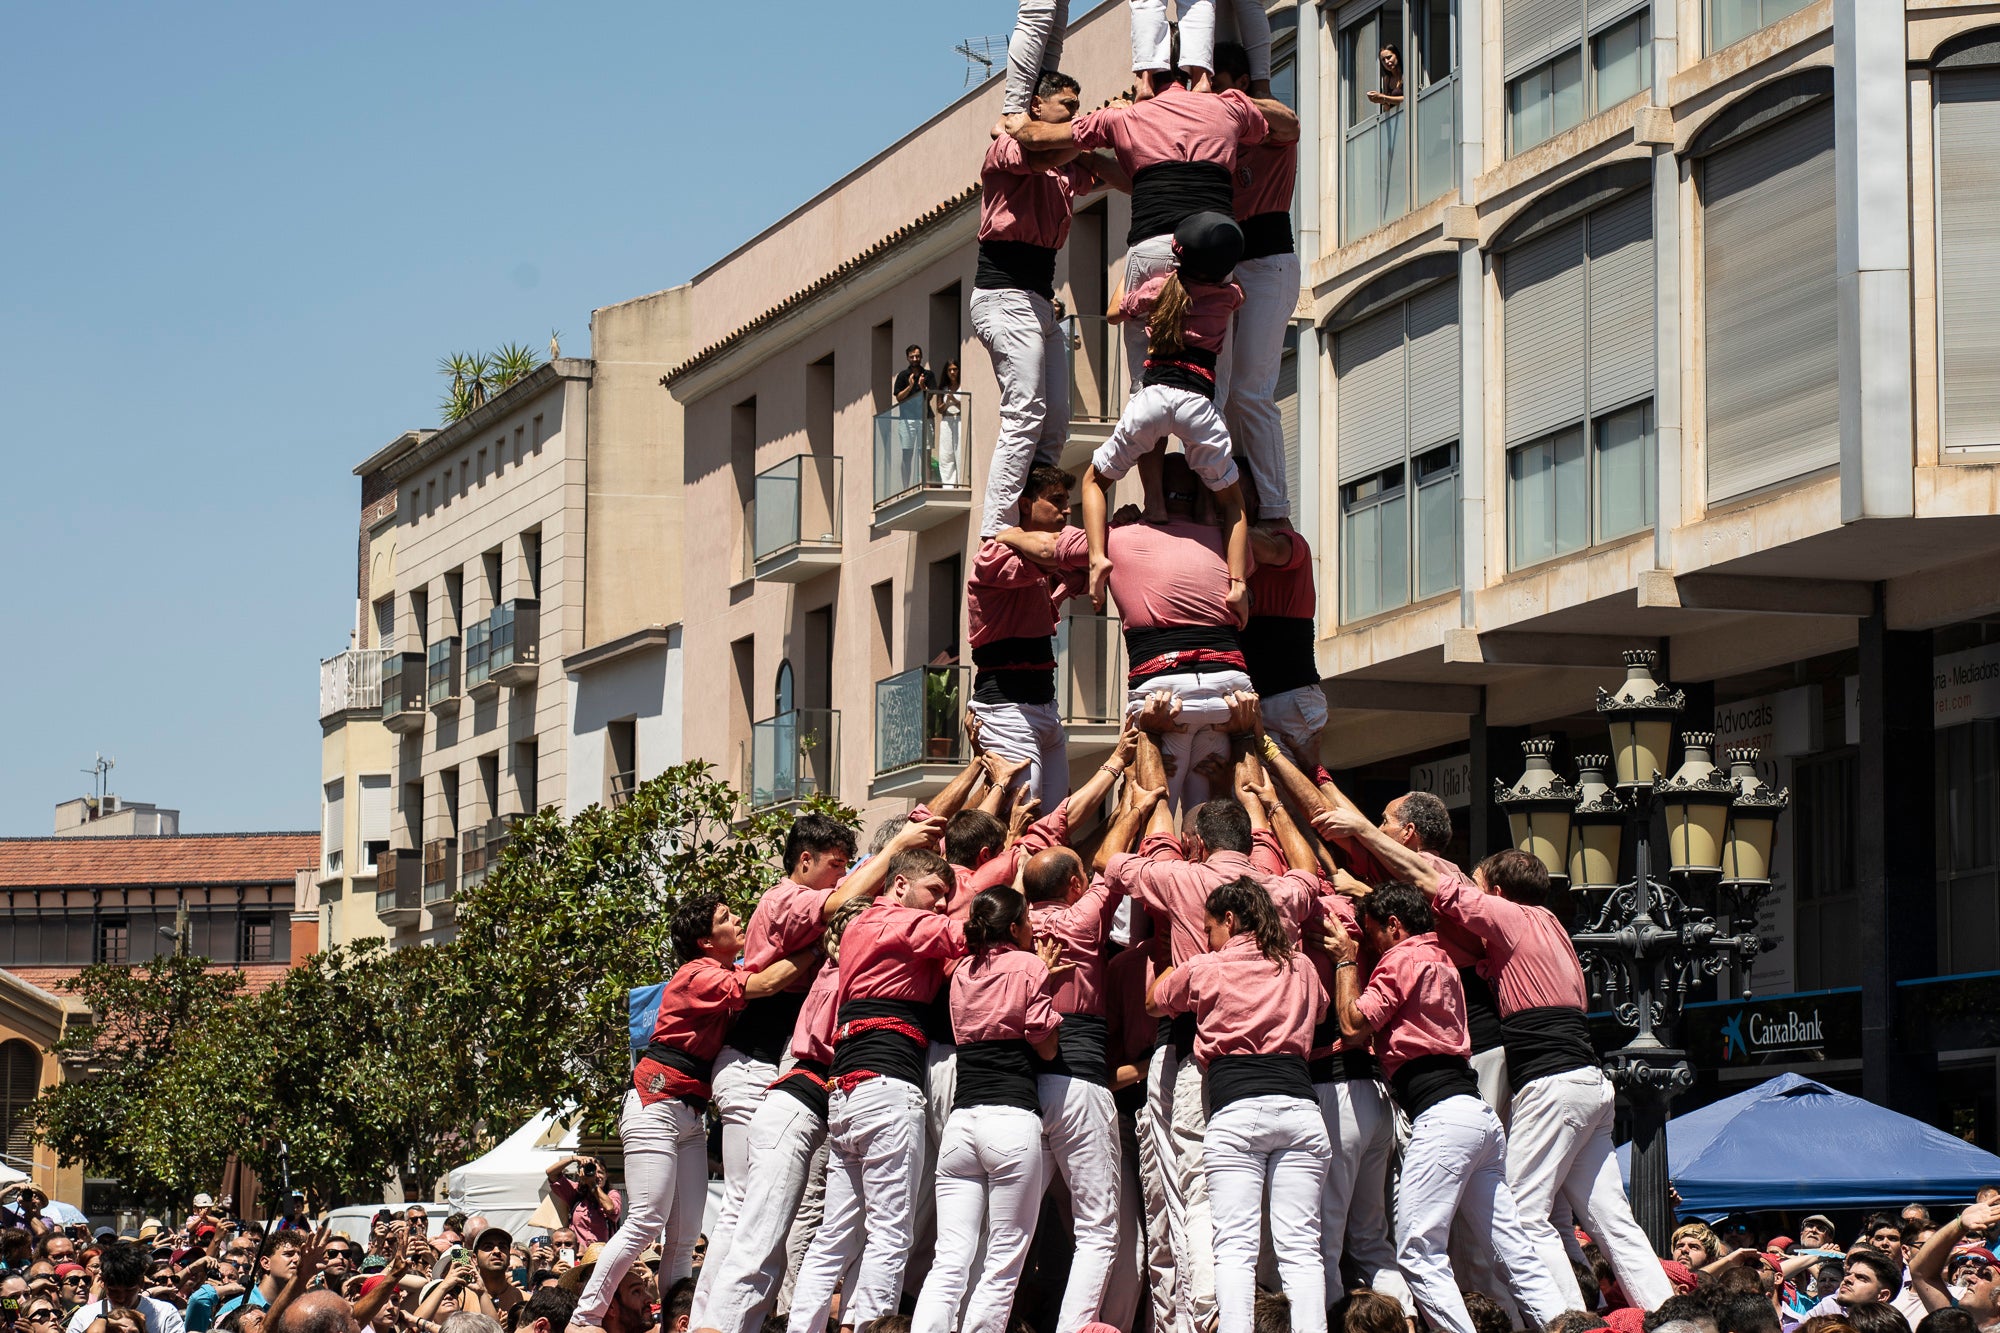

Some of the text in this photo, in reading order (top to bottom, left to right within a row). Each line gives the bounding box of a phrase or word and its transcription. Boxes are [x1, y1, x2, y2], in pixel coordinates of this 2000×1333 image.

[1715, 703, 1773, 735] Advocats
[1443, 768, 1460, 797] Glia
[1749, 1008, 1825, 1046] CaixaBank
